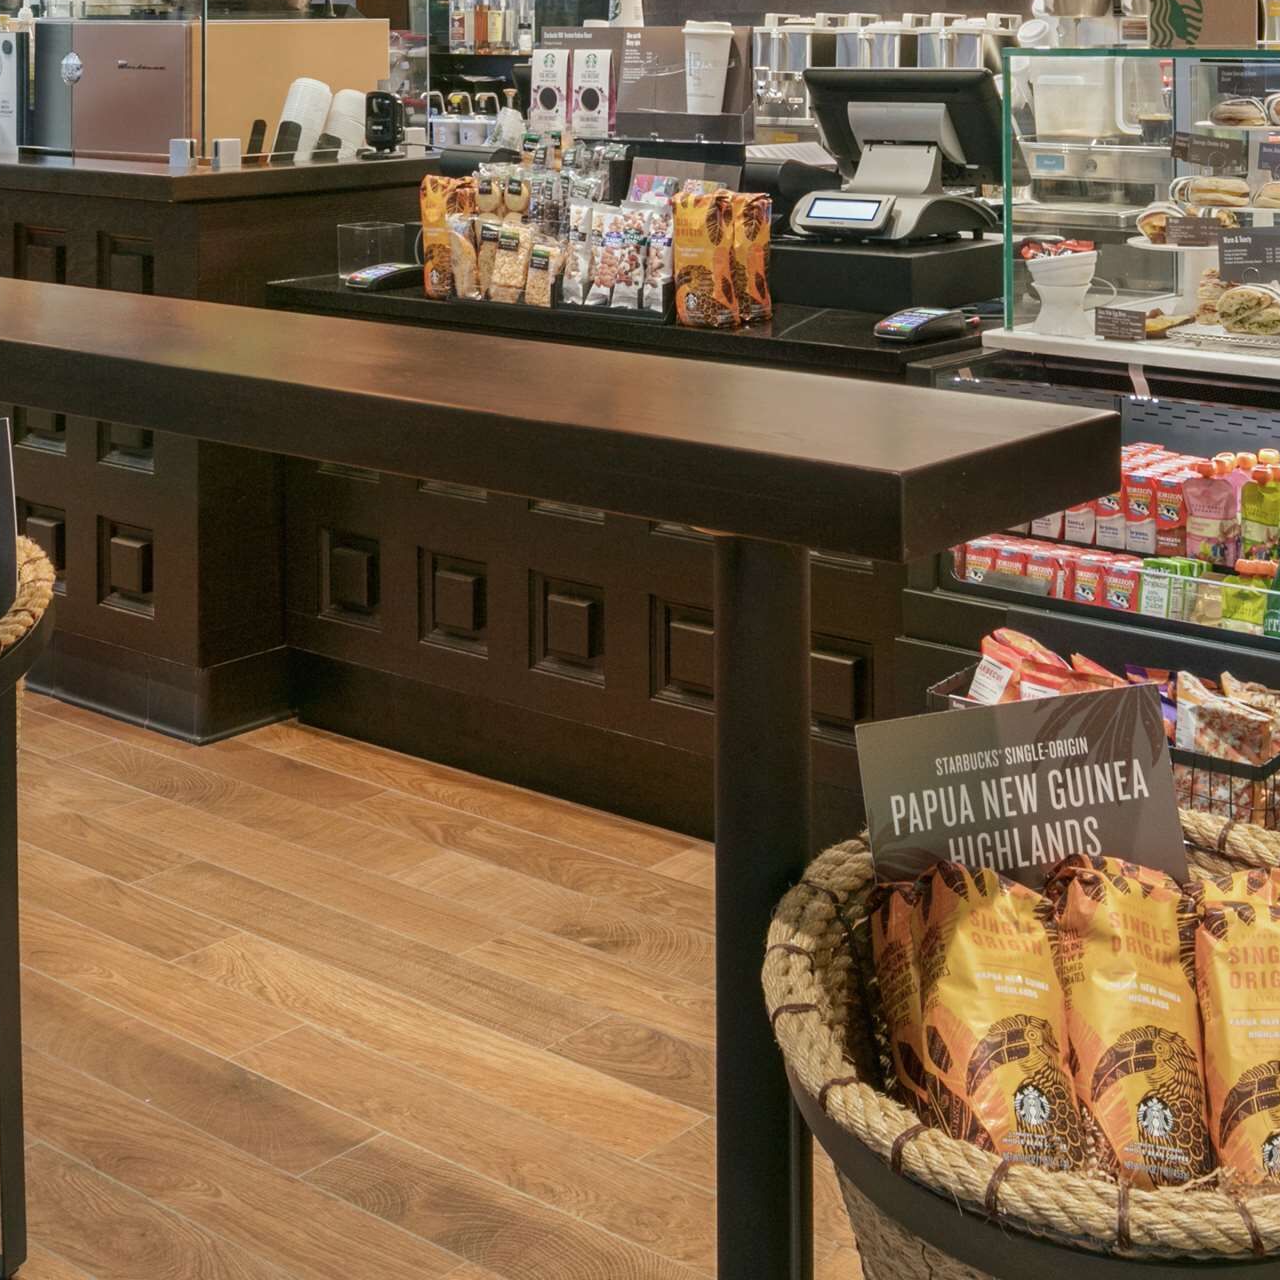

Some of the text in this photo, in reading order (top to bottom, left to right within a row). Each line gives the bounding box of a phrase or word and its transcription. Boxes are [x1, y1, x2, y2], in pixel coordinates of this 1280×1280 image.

[1004, 736, 1089, 766] SINGLE-ORIGIN
[890, 759, 1150, 836] PAPUA NEW GUINEA
[948, 816, 1103, 871] HIGHLANDS
[970, 910, 1036, 935] SINGLE
[1110, 912, 1171, 946] SINGLE
[972, 931, 1044, 957] ORIGIN
[1111, 934, 1170, 966] ORIGIN
[1260, 1018, 1279, 1027] NEW
